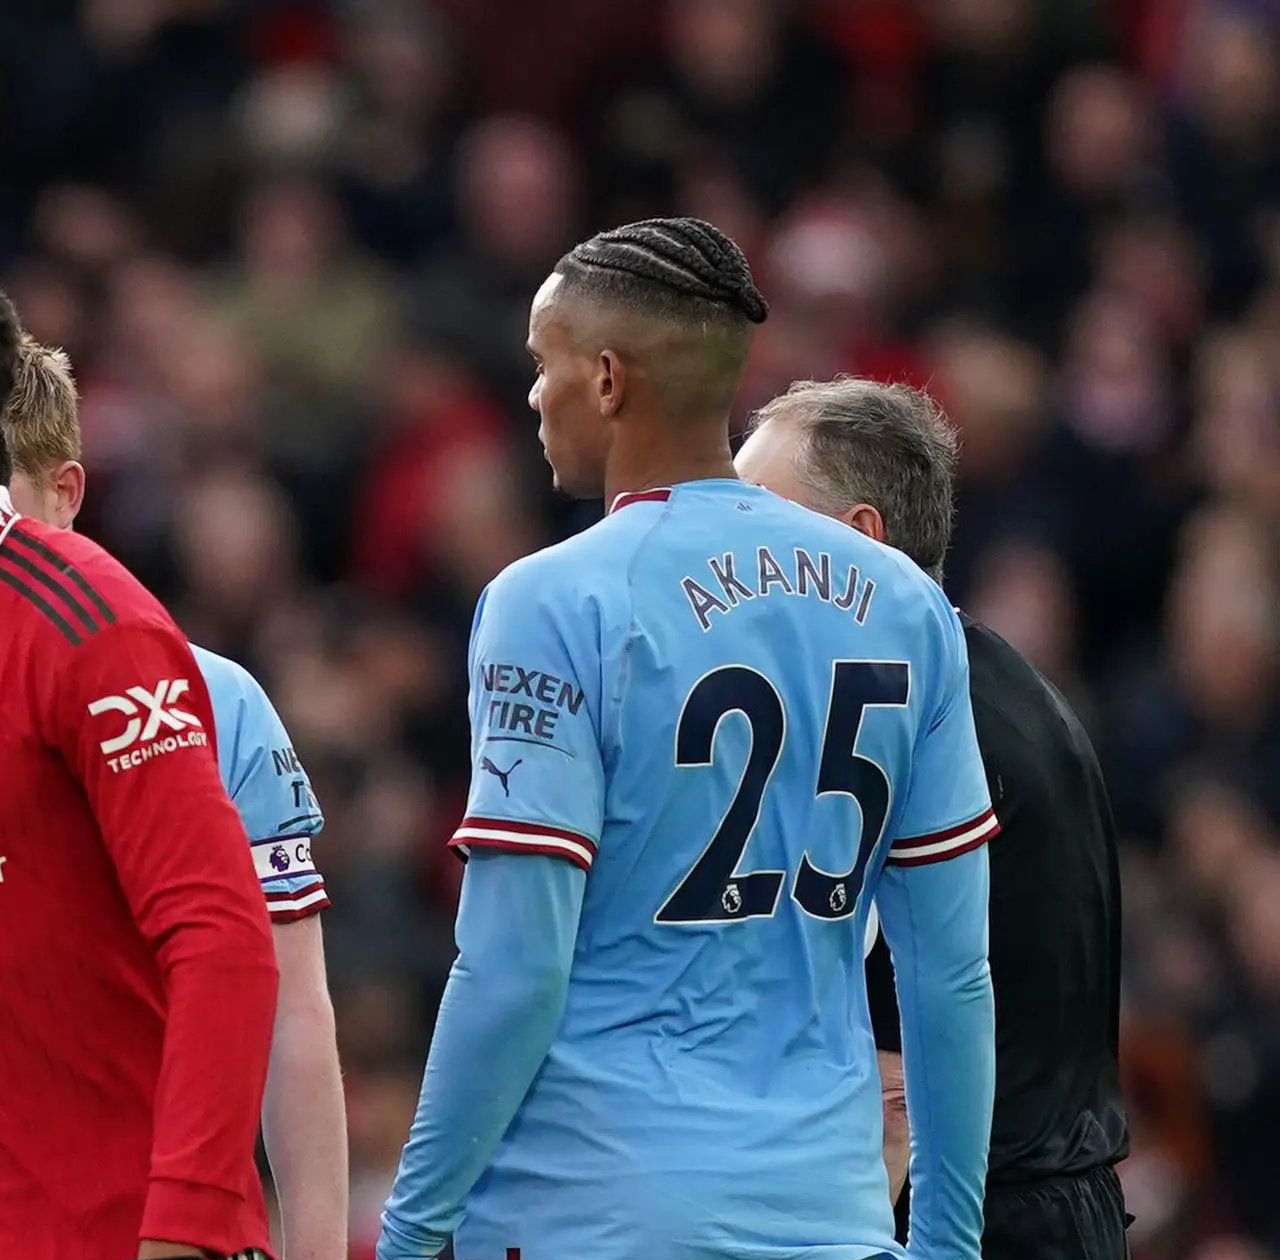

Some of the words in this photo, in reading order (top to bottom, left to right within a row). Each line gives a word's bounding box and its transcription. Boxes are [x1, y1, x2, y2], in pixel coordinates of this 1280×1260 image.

[679, 545, 877, 633] AKANJI
[481, 664, 584, 716] NEXEN
[488, 699, 559, 740] TIRE
[107, 731, 208, 774] TECHNOLOGY
[652, 658, 912, 925] 25
